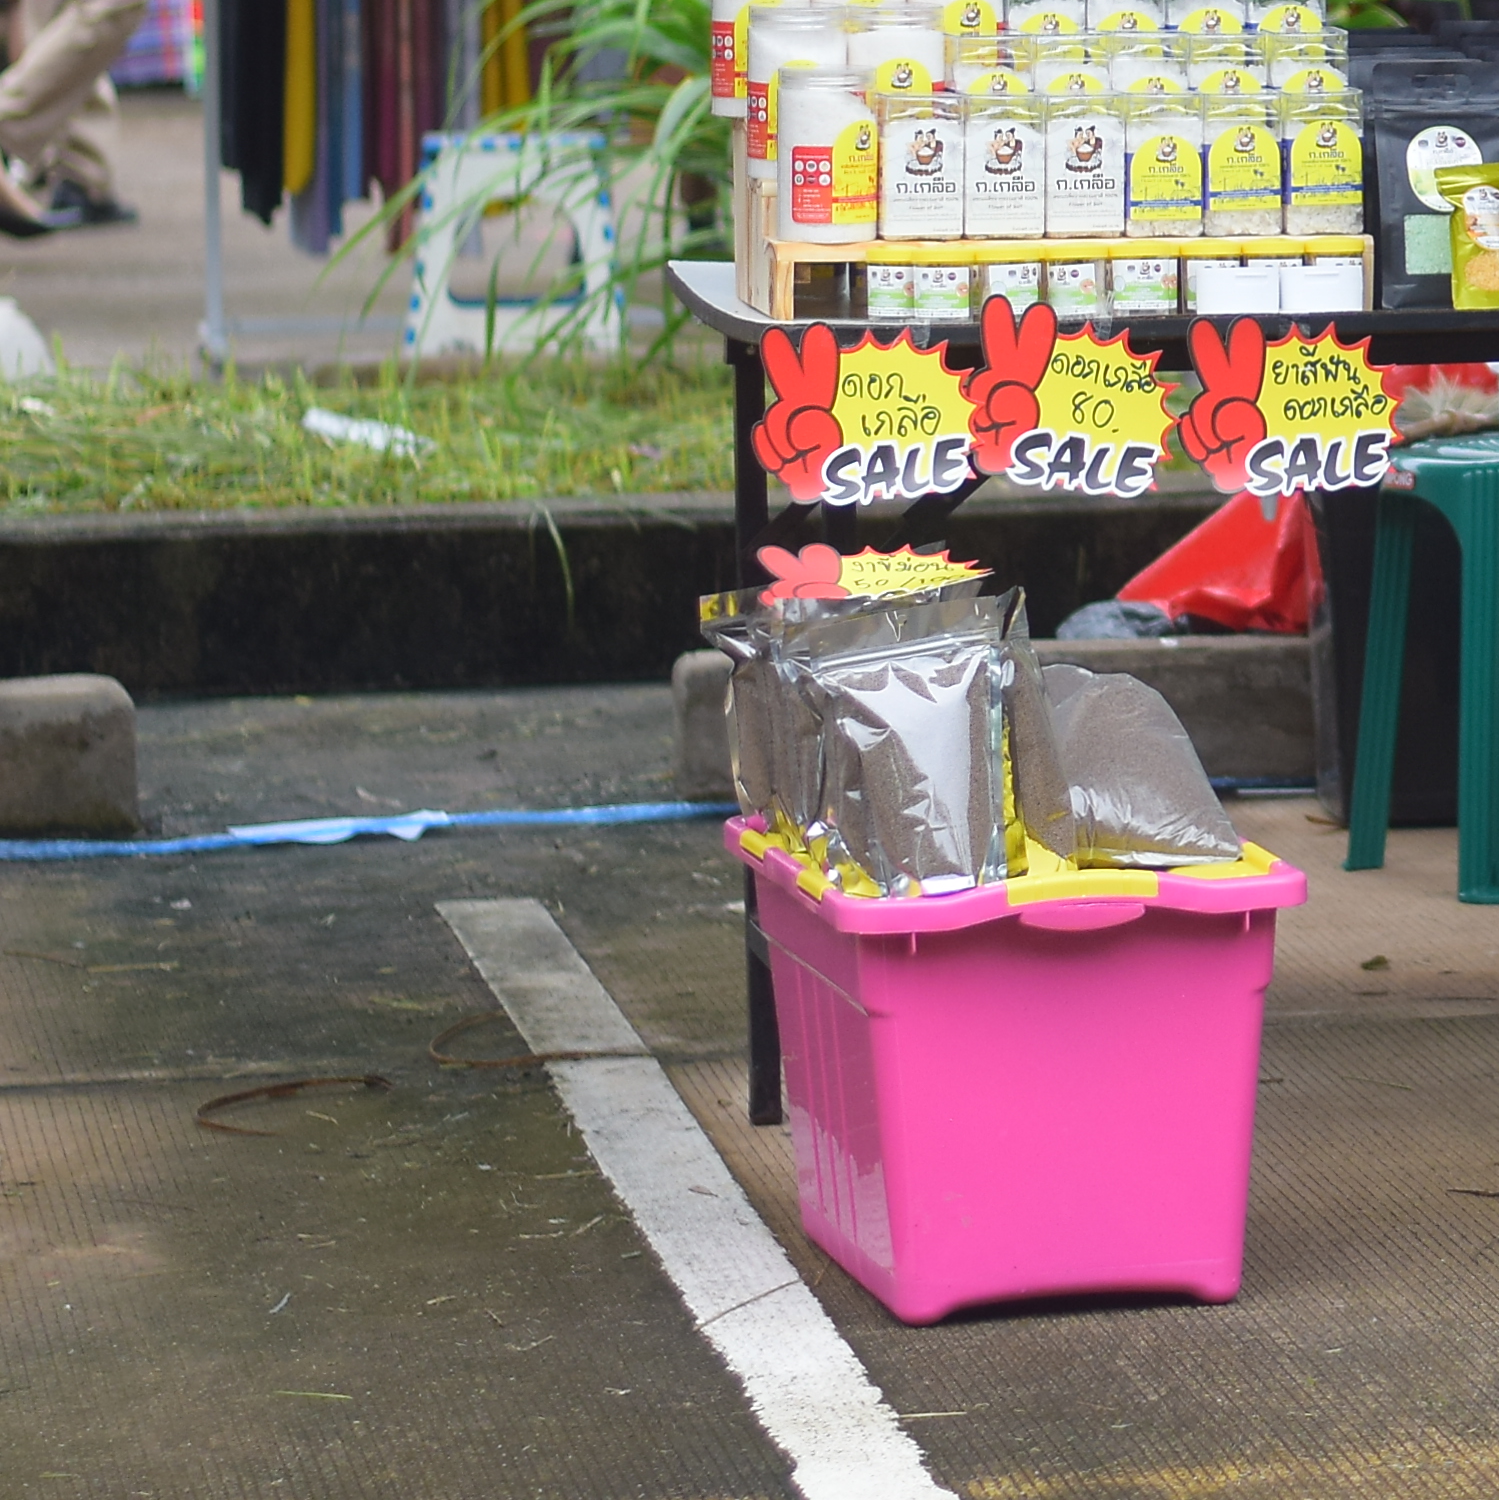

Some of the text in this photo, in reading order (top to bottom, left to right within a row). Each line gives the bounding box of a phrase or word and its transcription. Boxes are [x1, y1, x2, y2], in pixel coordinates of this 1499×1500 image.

[896, 176, 956, 194] ก.เกลือ
[975, 175, 1036, 193] ก.เกลือ
[1056, 173, 1116, 191] ก.เกลือ
[841, 372, 904, 401] ดอก
[824, 436, 968, 502] SALE
[1012, 431, 1157, 494] SALE
[1248, 432, 1388, 493] SALE
